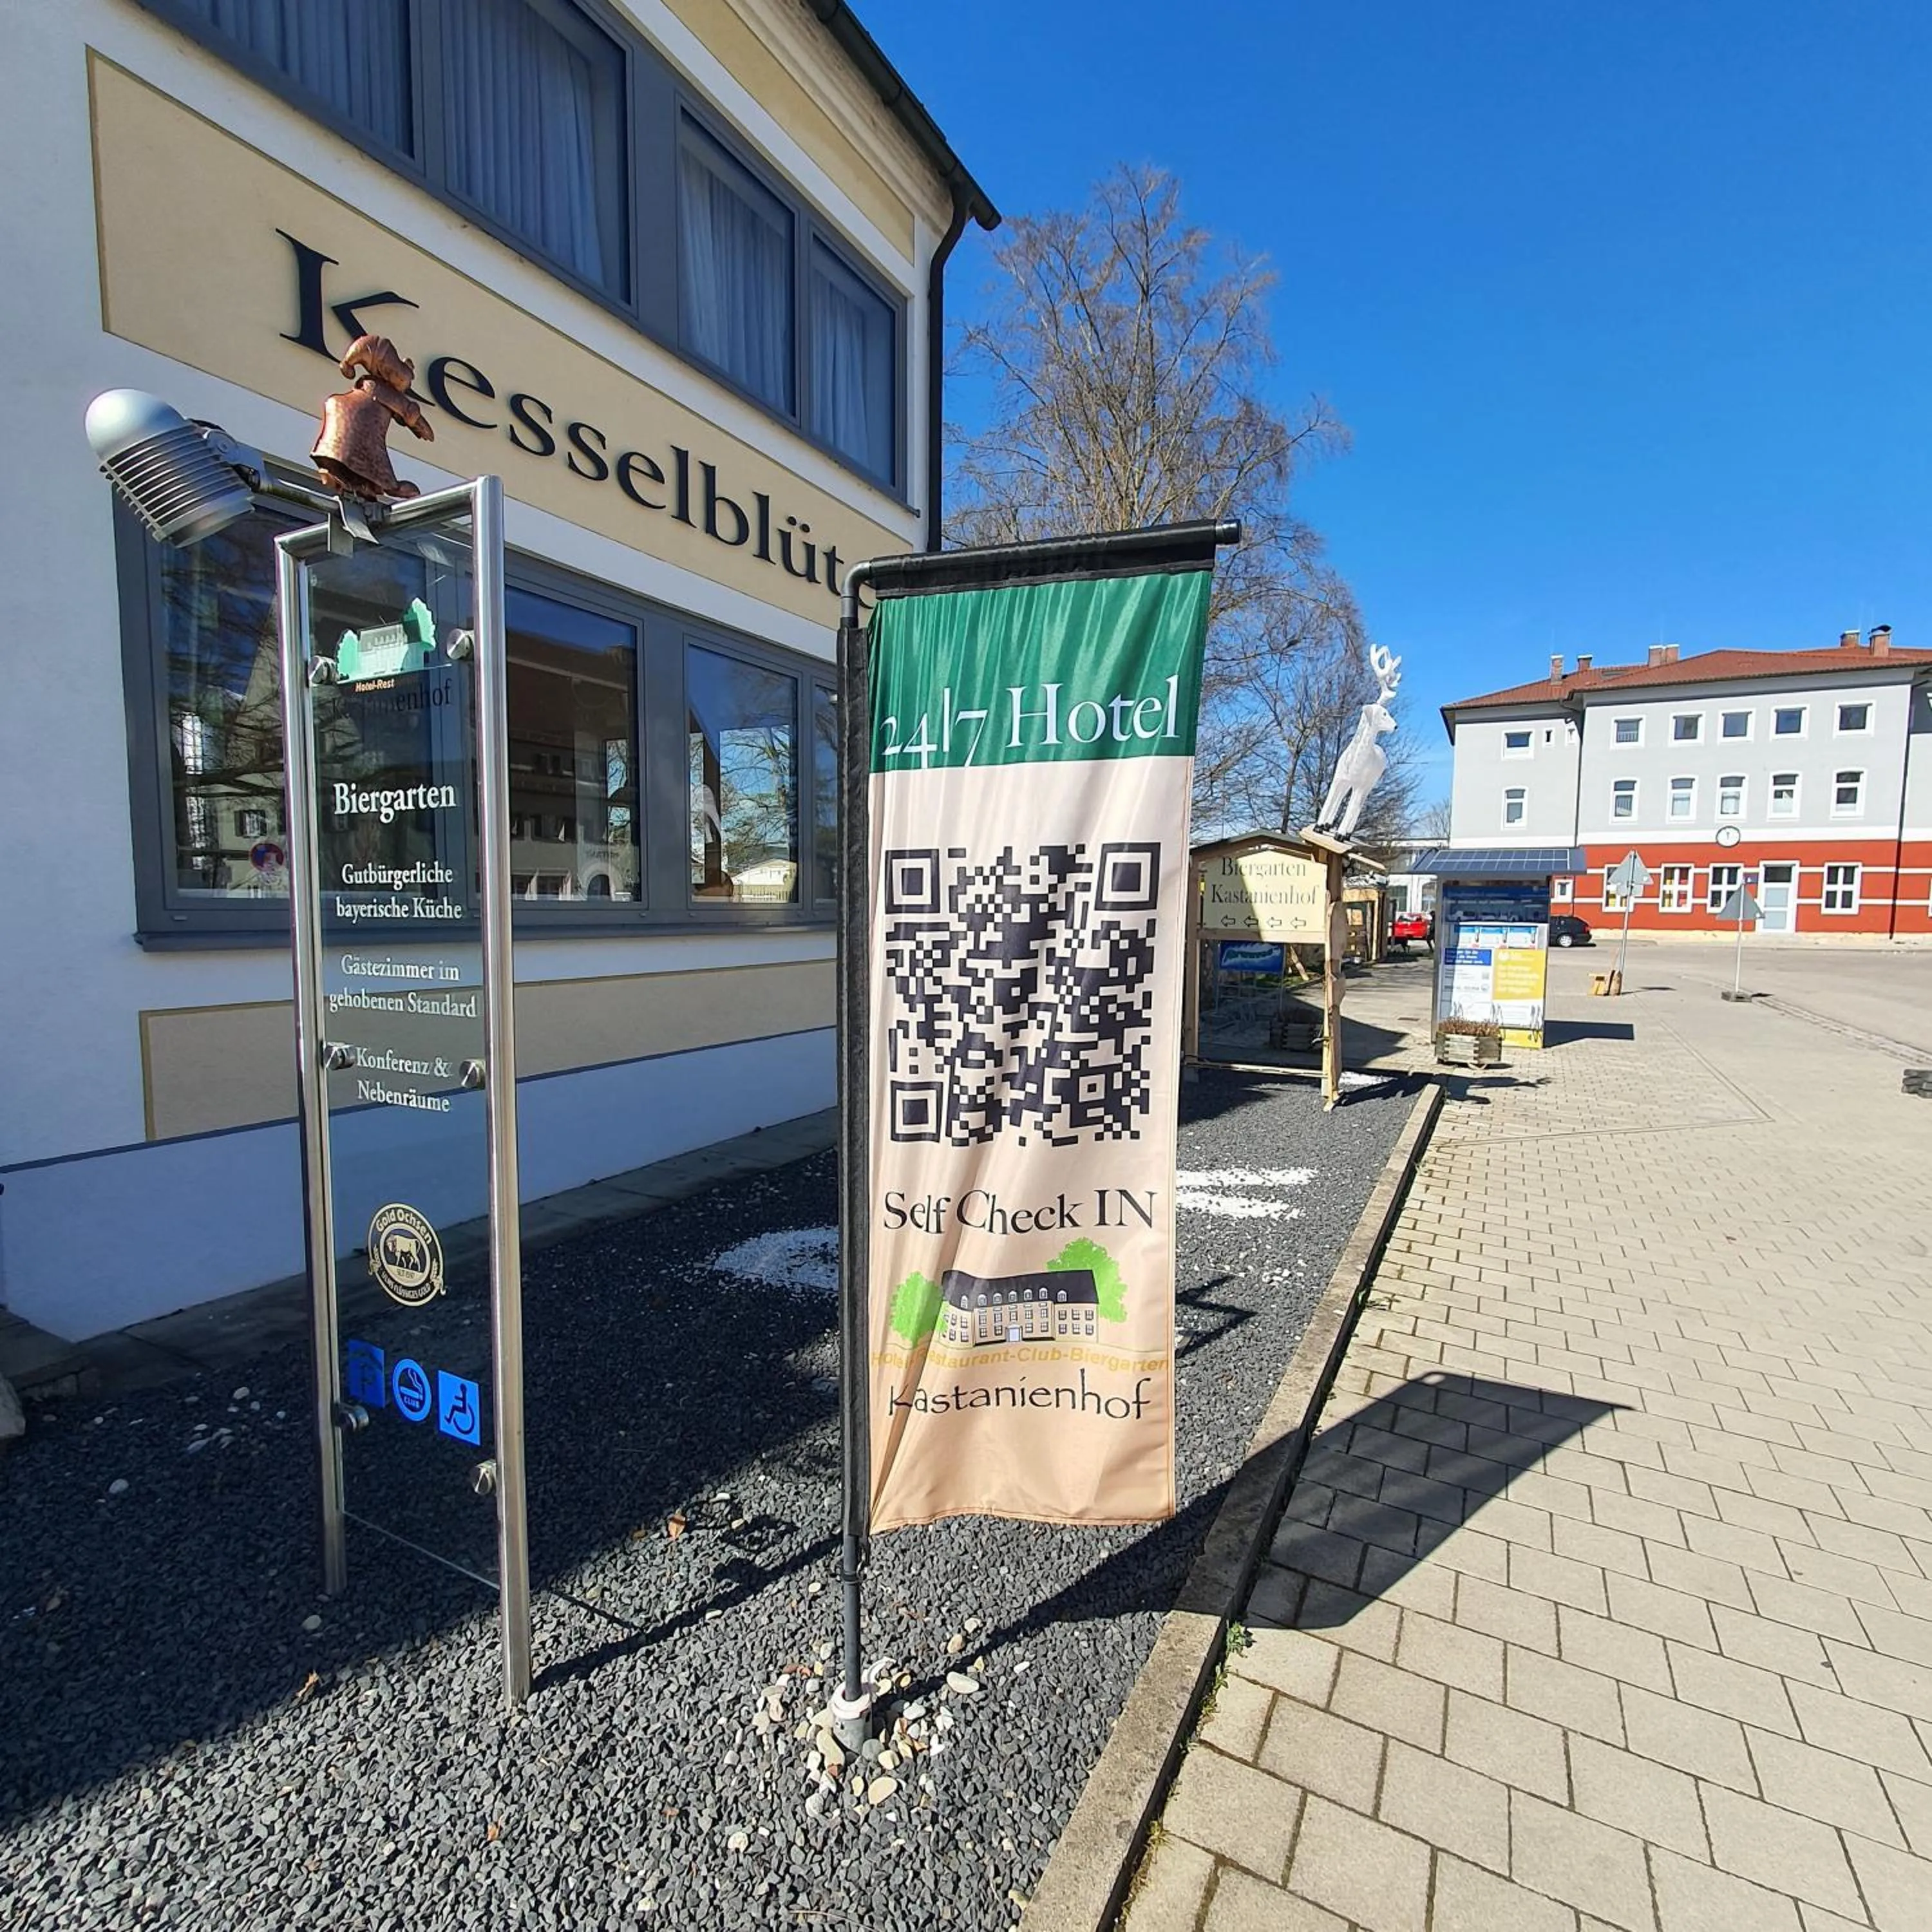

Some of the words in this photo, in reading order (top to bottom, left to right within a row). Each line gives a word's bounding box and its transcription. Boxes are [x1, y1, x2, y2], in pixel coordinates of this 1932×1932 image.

[1006, 674, 1180, 748] Hotel
[334, 783, 456, 824] Biergarten
[341, 860, 453, 891] Gutbürgerliche
[1221, 857, 1307, 879] Biergarten
[336, 896, 409, 924] bayerische
[412, 896, 462, 919] Küche
[1211, 884, 1320, 905] Kastanienhof
[341, 954, 435, 980] Gästezimmer
[439, 961, 460, 981] im
[329, 988, 404, 1014] gehobenen
[408, 992, 477, 1018] Standard
[356, 1046, 430, 1075] Konferenz
[433, 1057, 450, 1077] &
[357, 1079, 451, 1113] Nebenräume
[375, 1209, 397, 1232] Gold
[397, 1209, 433, 1244] Ochsen
[884, 1190, 951, 1235] Self
[956, 1189, 1087, 1235] Check
[1093, 1189, 1157, 1229] IN
[889, 1368, 1152, 1419] Kastanienhof
